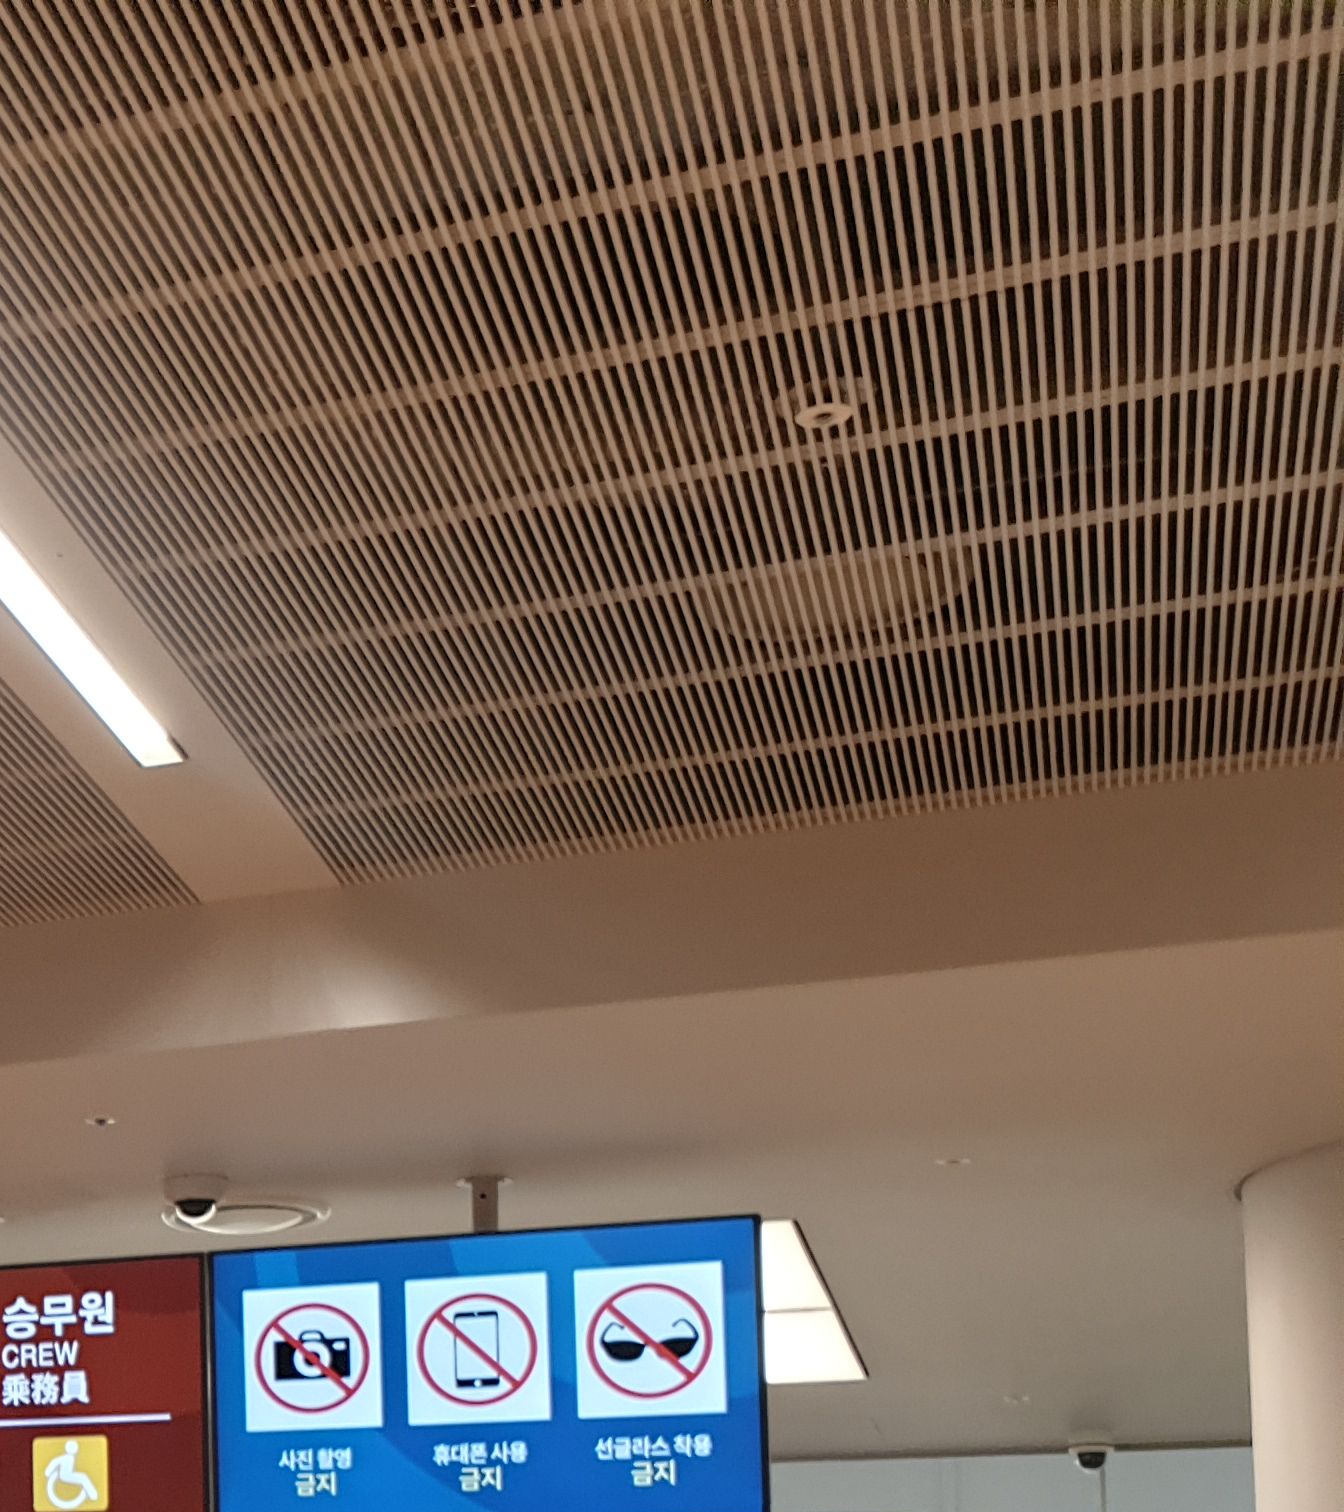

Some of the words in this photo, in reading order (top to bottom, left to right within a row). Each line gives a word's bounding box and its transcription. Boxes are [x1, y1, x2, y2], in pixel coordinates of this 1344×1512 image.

[2, 1291, 115, 1339] 승무원
[1, 1341, 80, 1369] CREW
[278, 1448, 313, 1472] 사진
[316, 1447, 352, 1471] 촬영
[433, 1443, 487, 1467] 휴대폰
[491, 1441, 528, 1463] 사용
[595, 1436, 671, 1462] 선글라스
[673, 1434, 711, 1457] 착용
[295, 1472, 337, 1496] 금지
[459, 1466, 502, 1492] 금지
[630, 1460, 676, 1487] 금지
